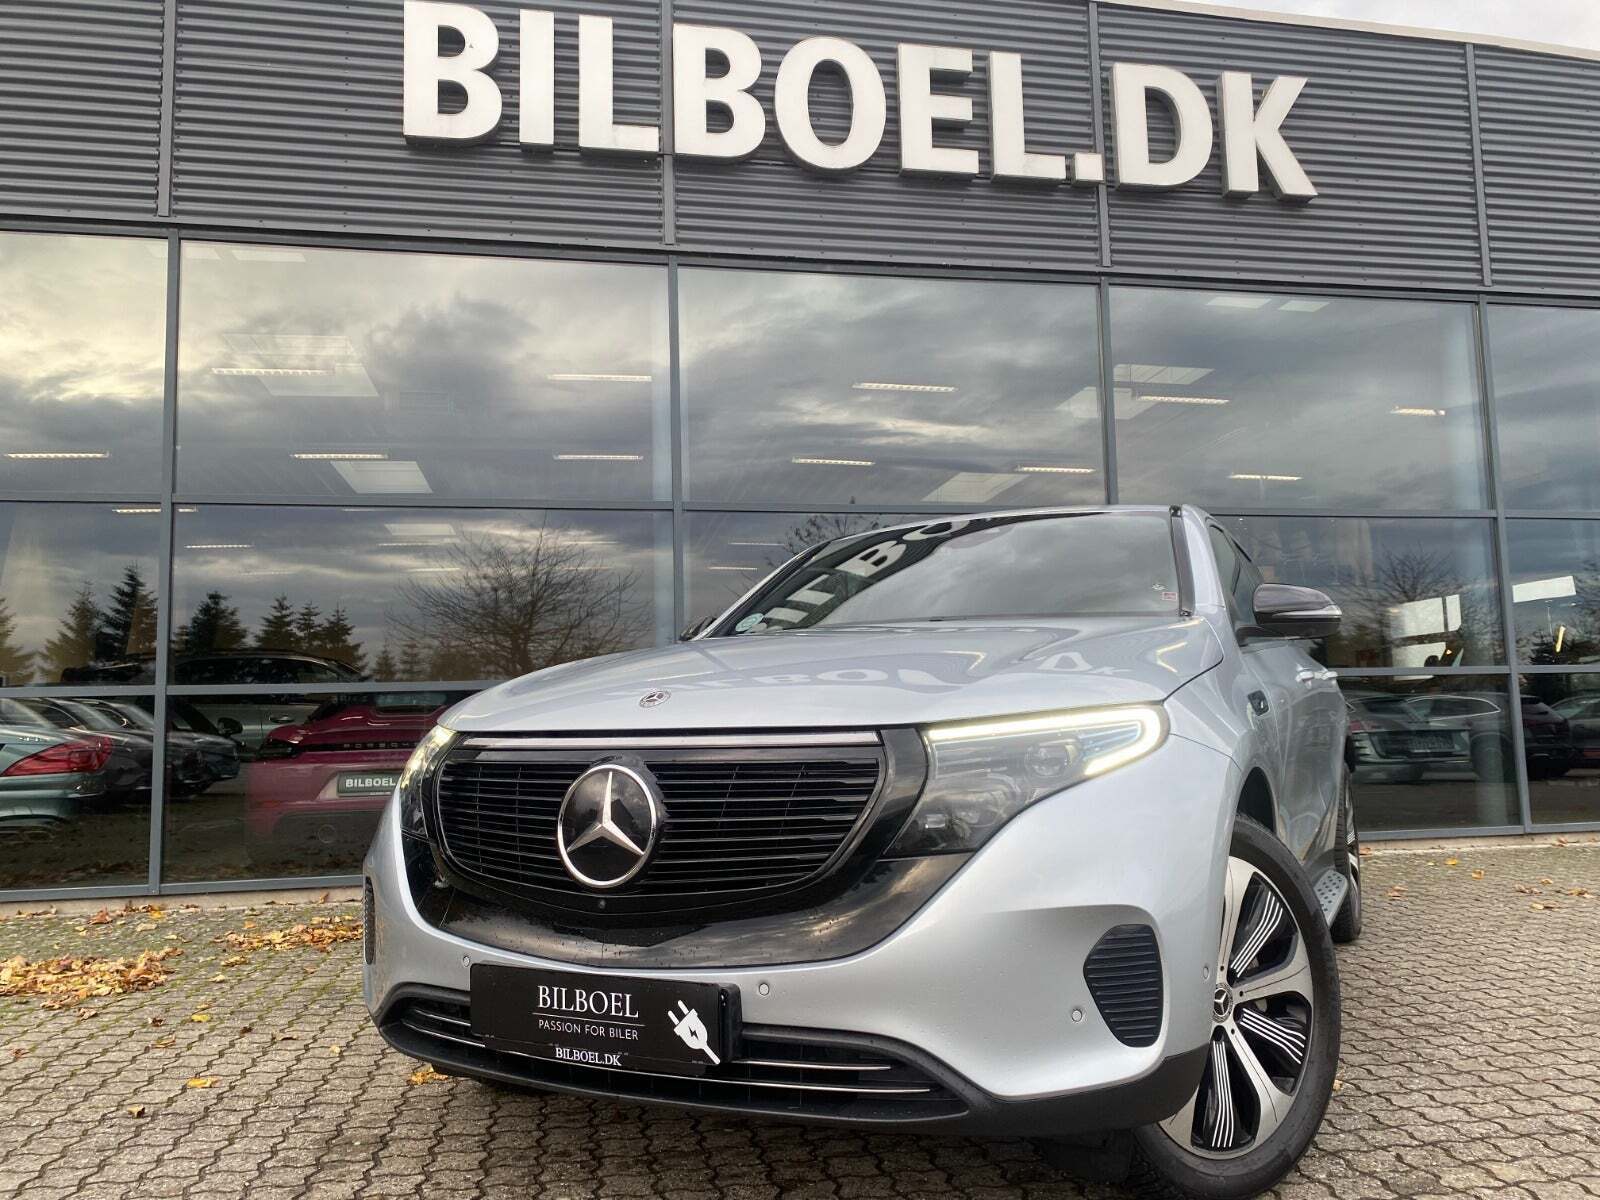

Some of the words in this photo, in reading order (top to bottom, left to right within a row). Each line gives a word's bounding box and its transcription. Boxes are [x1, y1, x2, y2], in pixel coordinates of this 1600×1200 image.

[403, 0, 1320, 202] BILBOEL.DK
[345, 778, 395, 788] BILBOEL
[537, 985, 639, 1018] BILBOEL
[538, 1019, 581, 1034] PASSION
[584, 1024, 606, 1038] FOR
[609, 1028, 639, 1041] BILER
[555, 1047, 622, 1067] BILBOEL.DK
